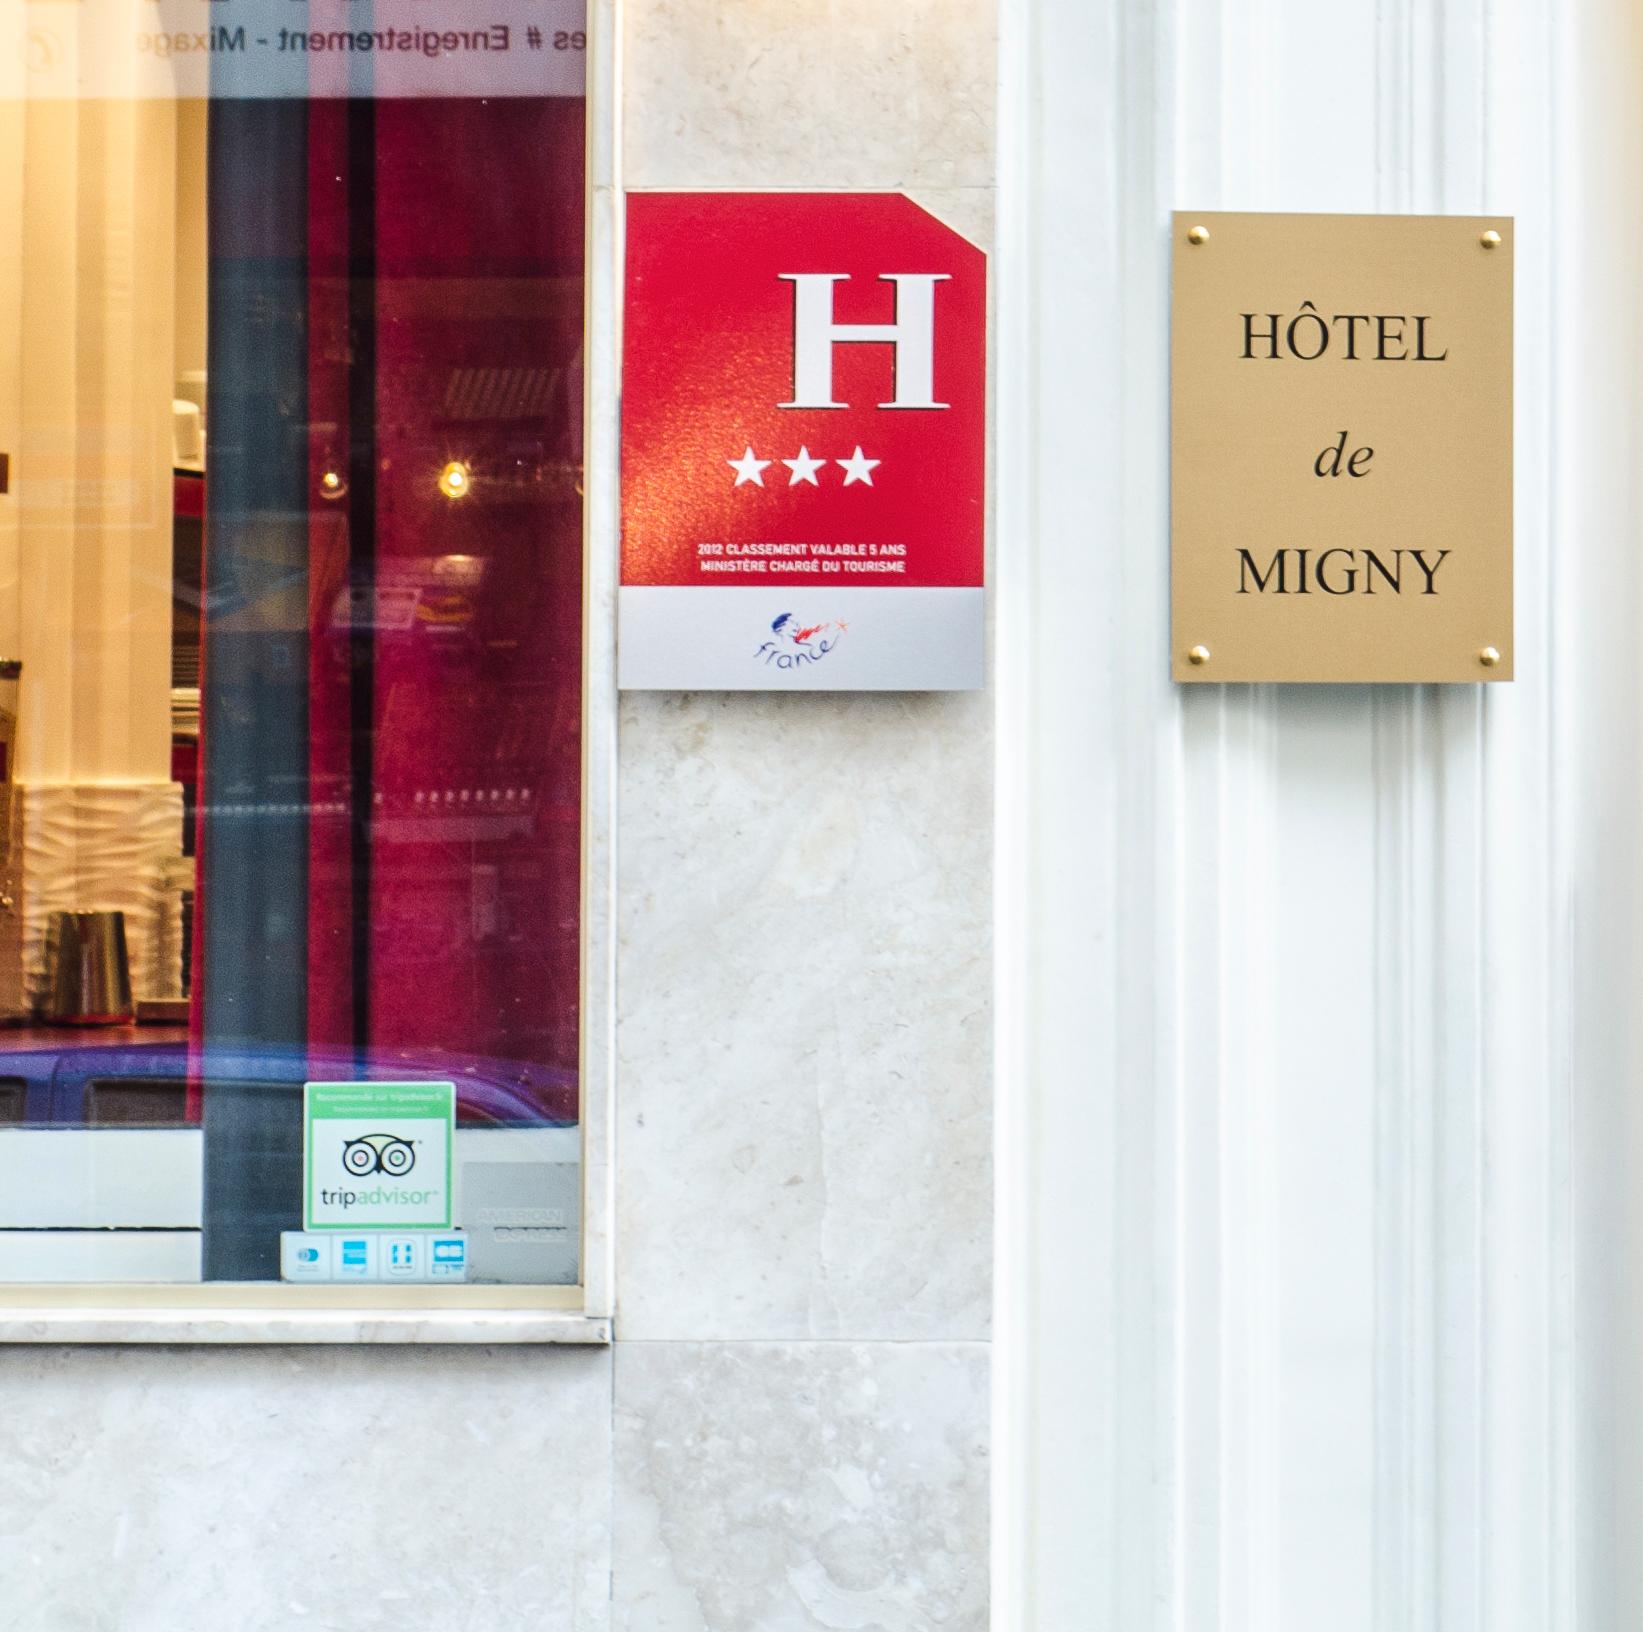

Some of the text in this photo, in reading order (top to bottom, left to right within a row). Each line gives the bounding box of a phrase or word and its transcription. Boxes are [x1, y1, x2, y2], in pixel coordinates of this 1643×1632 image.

[776, 273, 952, 409] H
[1239, 300, 1449, 362] HÔTEL
[1313, 430, 1374, 479] de
[697, 543, 907, 556] 2012 CLASSEMENT VALABLE 5 ANS
[700, 558, 907, 573] MINISTÈRE CHARGÉ DU TOURISME
[1235, 547, 1452, 596] MIGNY
[321, 1186, 432, 1210] tripadvisor
